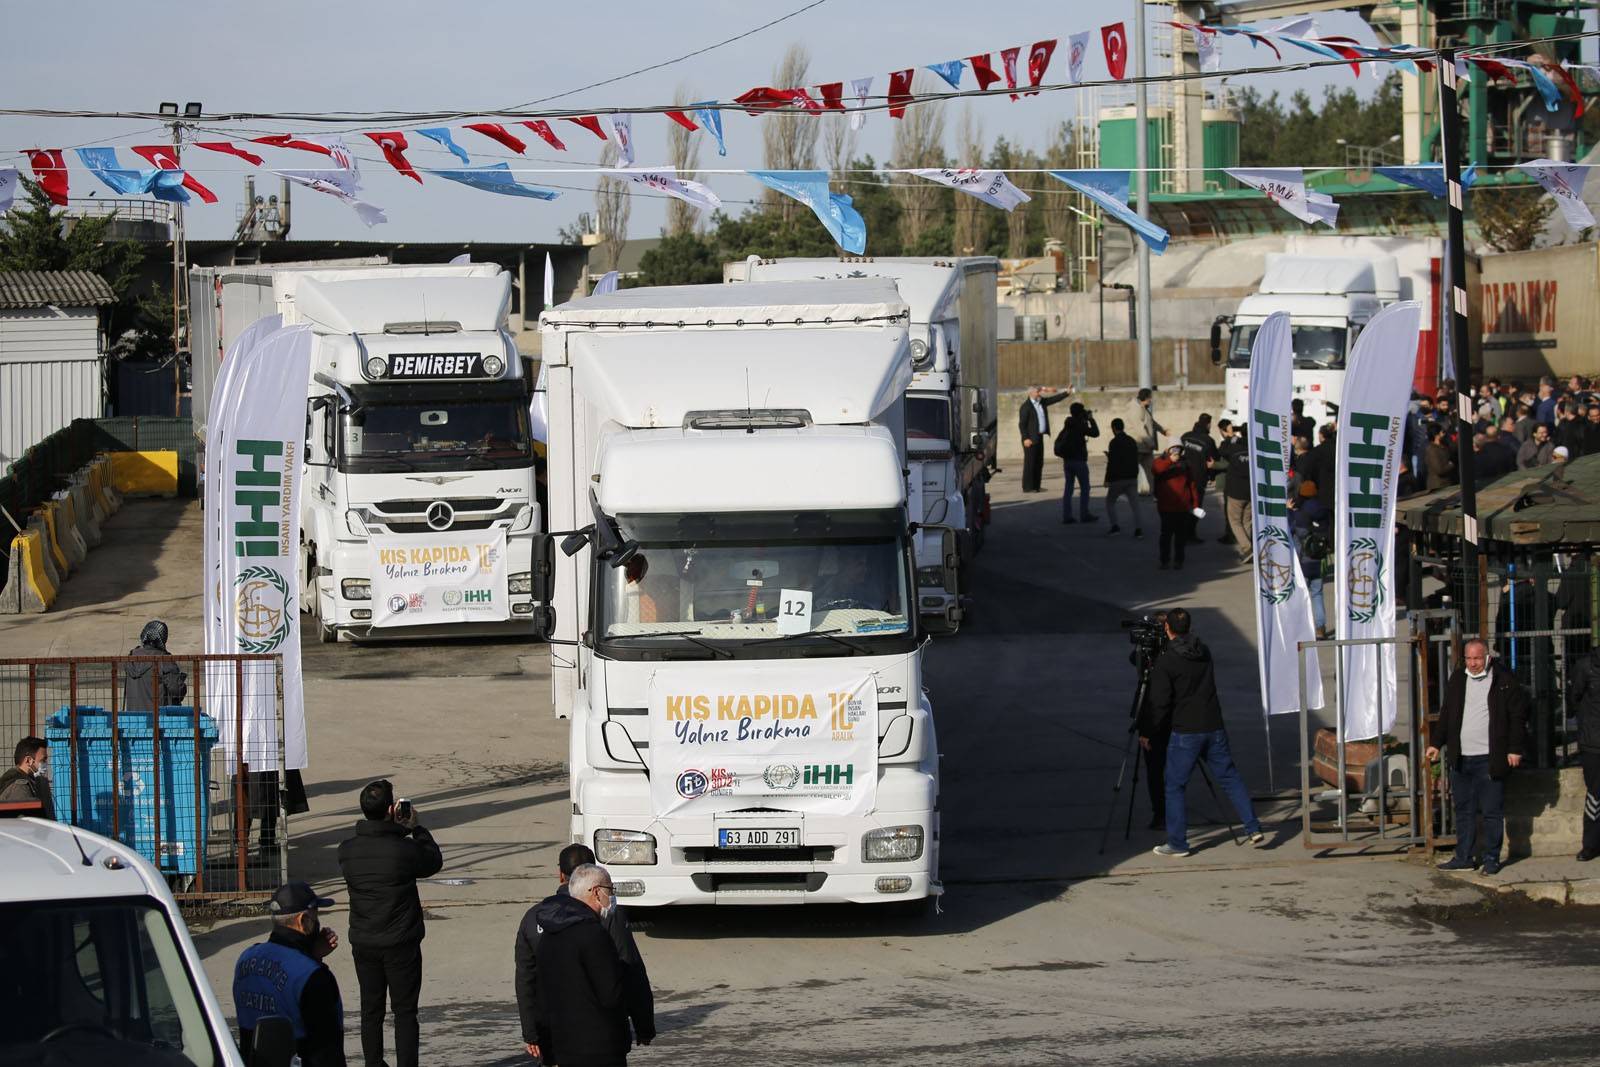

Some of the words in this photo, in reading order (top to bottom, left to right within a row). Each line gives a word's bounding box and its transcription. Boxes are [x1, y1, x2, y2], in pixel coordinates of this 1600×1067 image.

[393, 354, 479, 376] DEMİRBEY
[1389, 416, 1401, 447] VAKFI
[284, 441, 295, 472] VAKFI
[282, 474, 292, 518] YARDIM
[411, 545, 472, 565] KAPIDA
[783, 600, 806, 617] 12
[716, 693, 818, 721] KAPIDA
[674, 720, 729, 745] Yalnız
[736, 717, 811, 742] Bırakma
[727, 831, 741, 844] 63
[747, 831, 769, 844] ADD
[775, 831, 795, 844] 291
